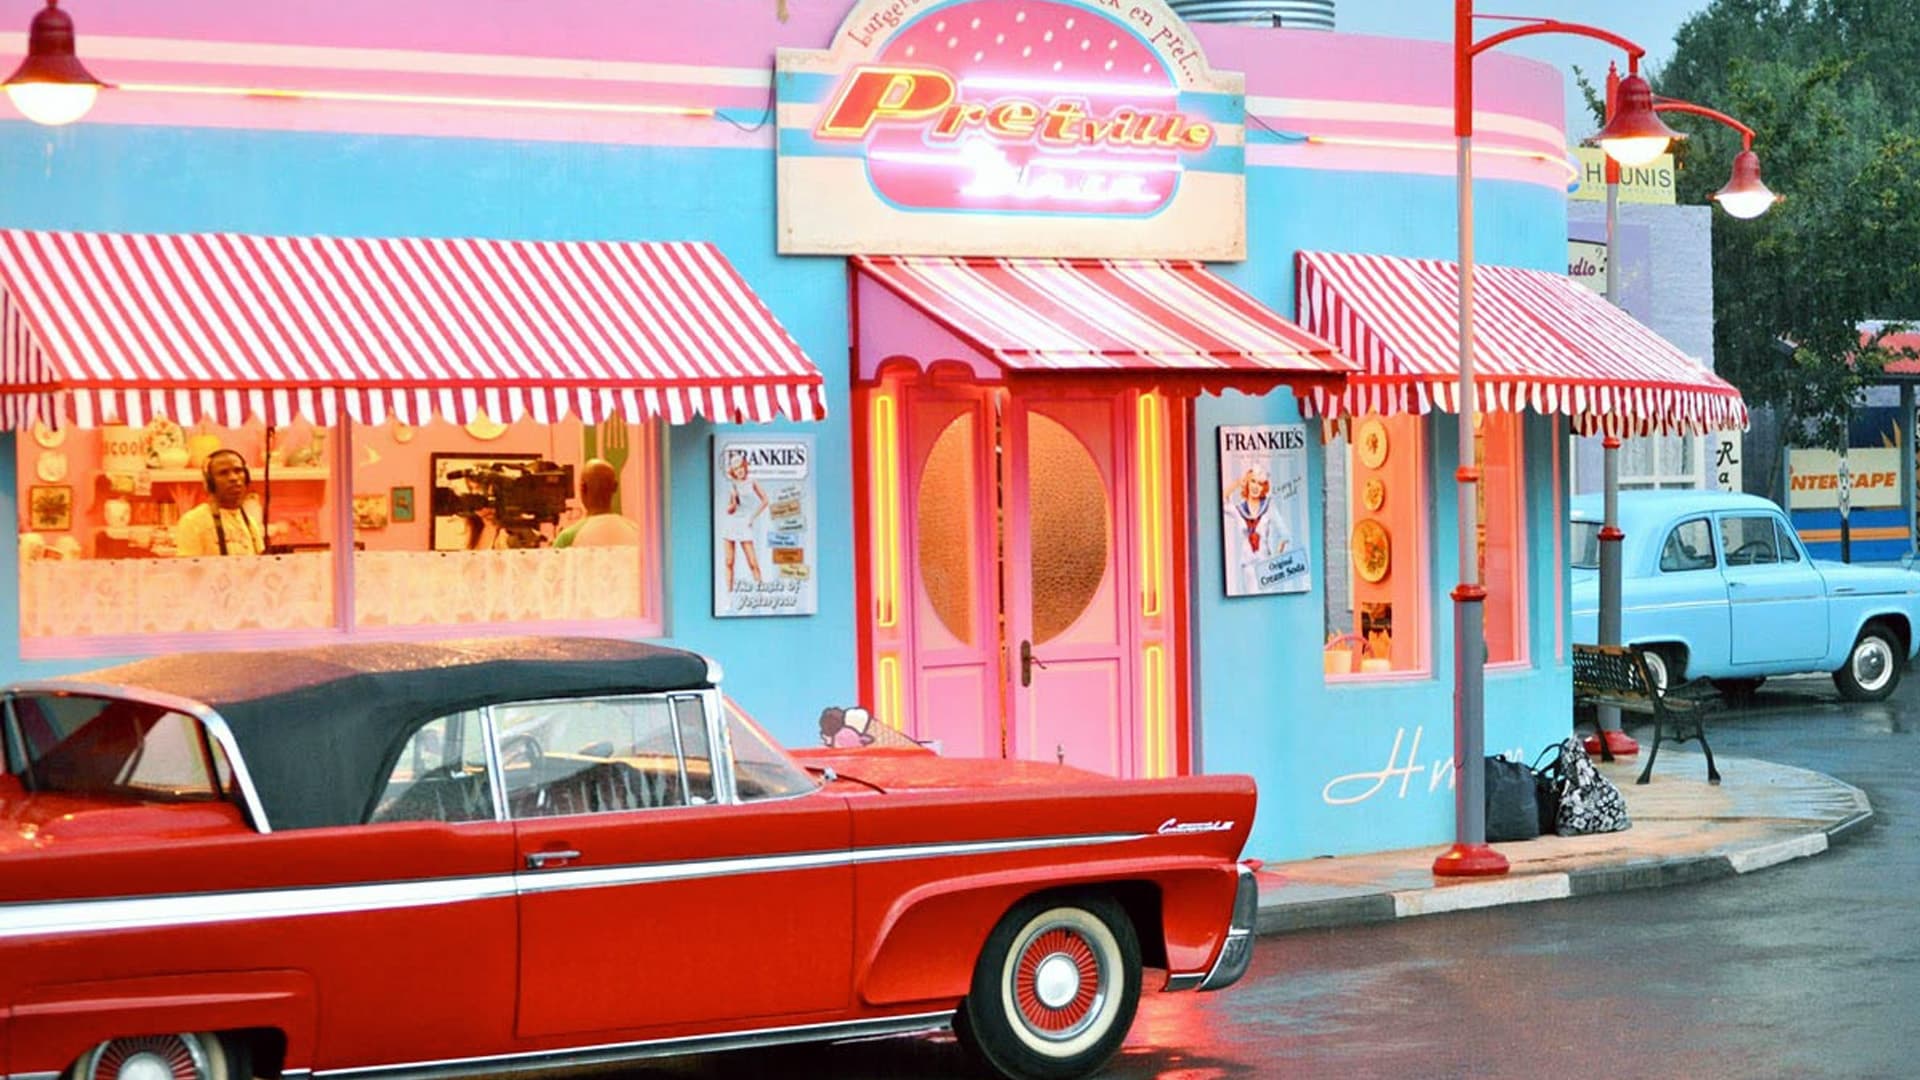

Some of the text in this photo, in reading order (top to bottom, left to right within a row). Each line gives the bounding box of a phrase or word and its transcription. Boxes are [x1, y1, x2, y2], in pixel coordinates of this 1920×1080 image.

[815, 66, 1214, 149] Pretville
[1586, 162, 1671, 188] HUNIS
[1225, 428, 1305, 451] FRANKIE'S
